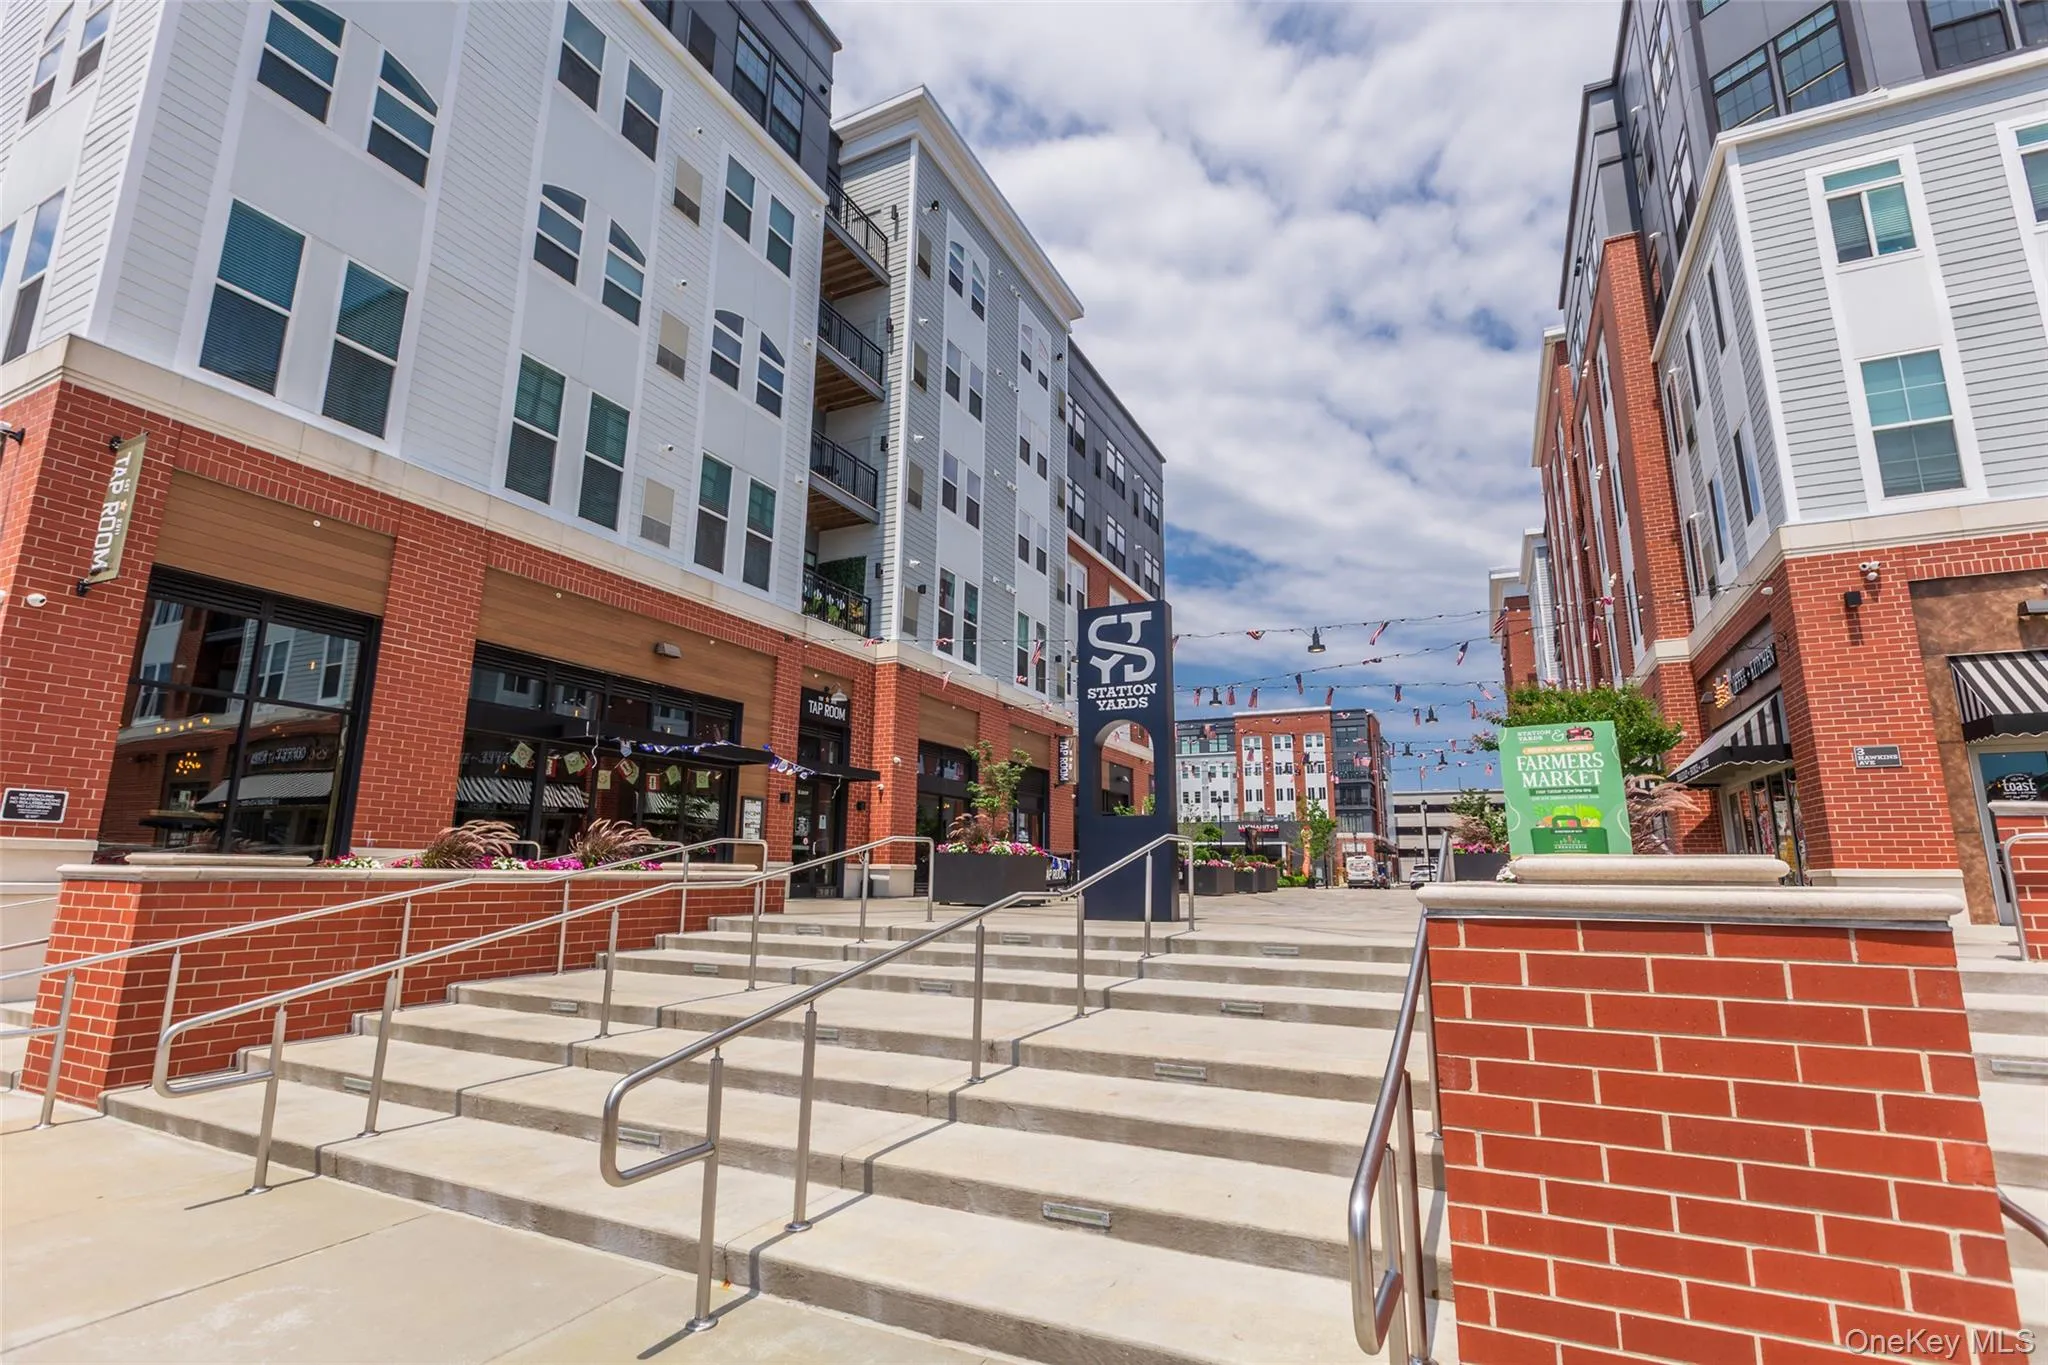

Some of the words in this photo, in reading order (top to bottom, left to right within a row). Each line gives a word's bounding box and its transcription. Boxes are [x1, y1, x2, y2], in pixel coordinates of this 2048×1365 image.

[109, 451, 132, 495] TAP
[91, 500, 122, 571] ROOM
[1087, 683, 1158, 700] STATION
[808, 700, 824, 715] TAP
[824, 704, 846, 721] ROOM
[1096, 697, 1149, 711] YARDS
[1517, 729, 1551, 737] STATION
[1059, 739, 1069, 756] TAP
[1856, 747, 1866, 756] 3
[1059, 756, 1069, 782] ROOM
[1516, 752, 1605, 772] FARMERS
[1521, 769, 1603, 788] MARKET
[2001, 778, 2037, 792] toast
[1052, 868, 1067, 880] ROOM
